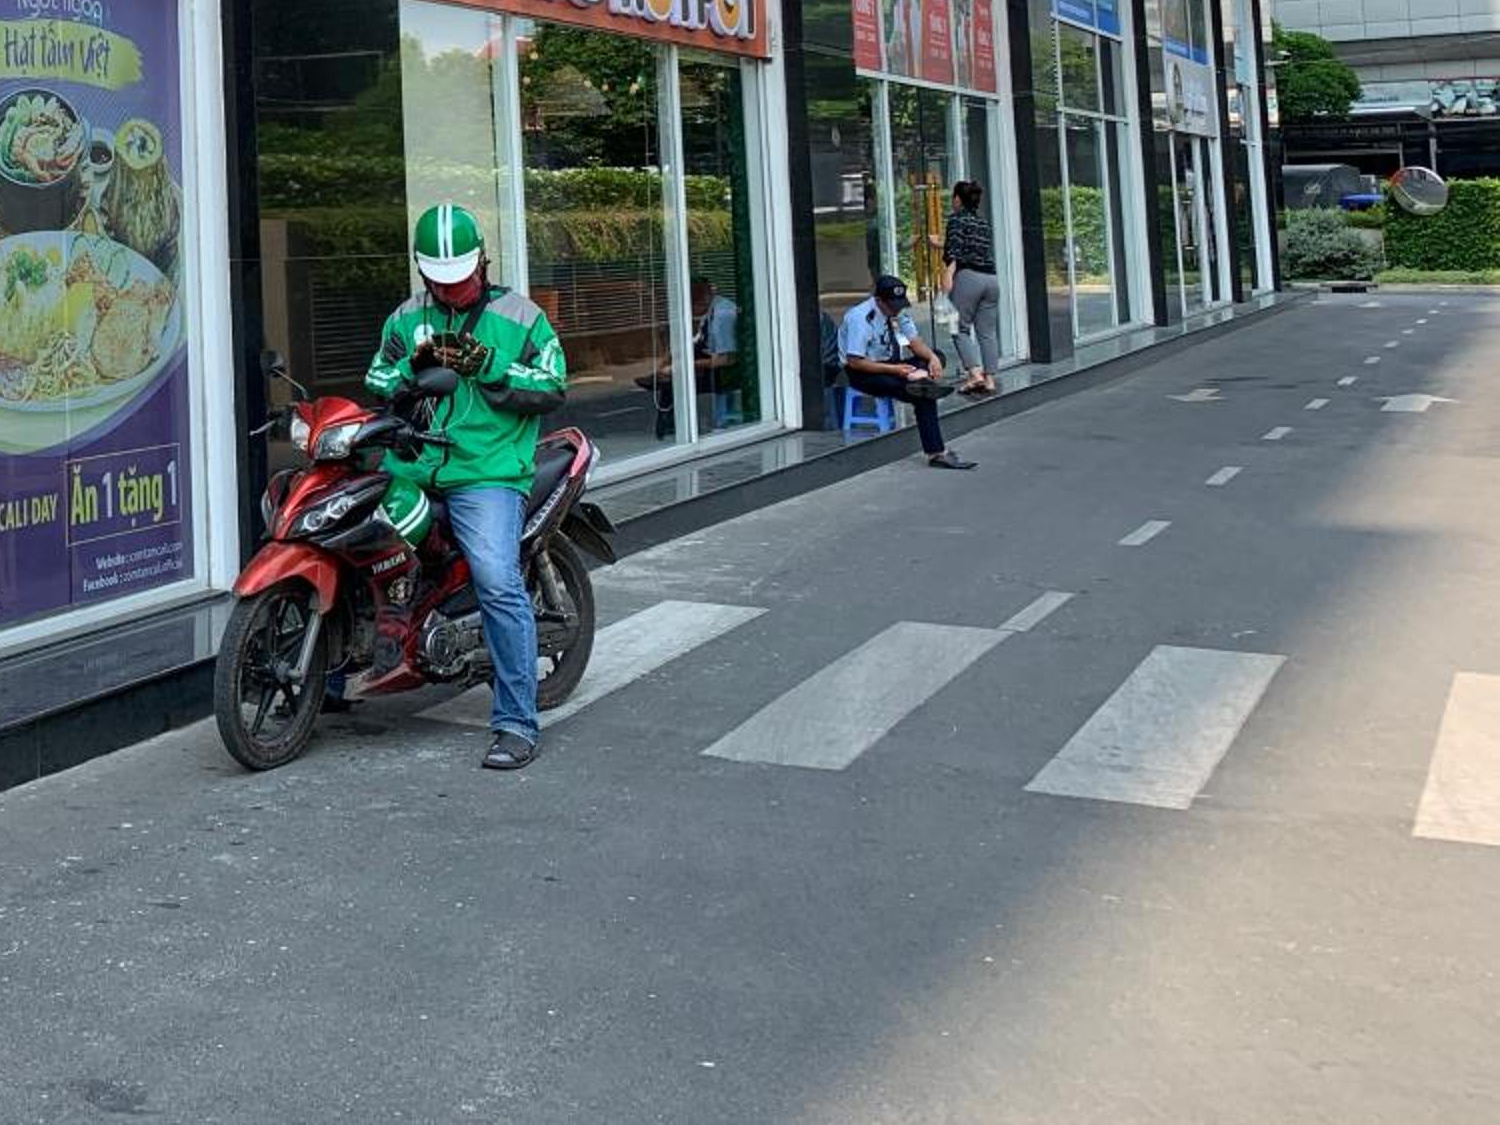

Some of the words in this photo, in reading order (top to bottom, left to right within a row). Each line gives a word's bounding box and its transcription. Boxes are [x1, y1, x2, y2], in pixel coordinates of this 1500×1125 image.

[3, 26, 37, 75] Hạt
[31, 492, 60, 526] DAY
[70, 463, 99, 526] Ăn
[102, 471, 113, 518] 1
[117, 465, 164, 528] tặng
[167, 459, 177, 506] 1
